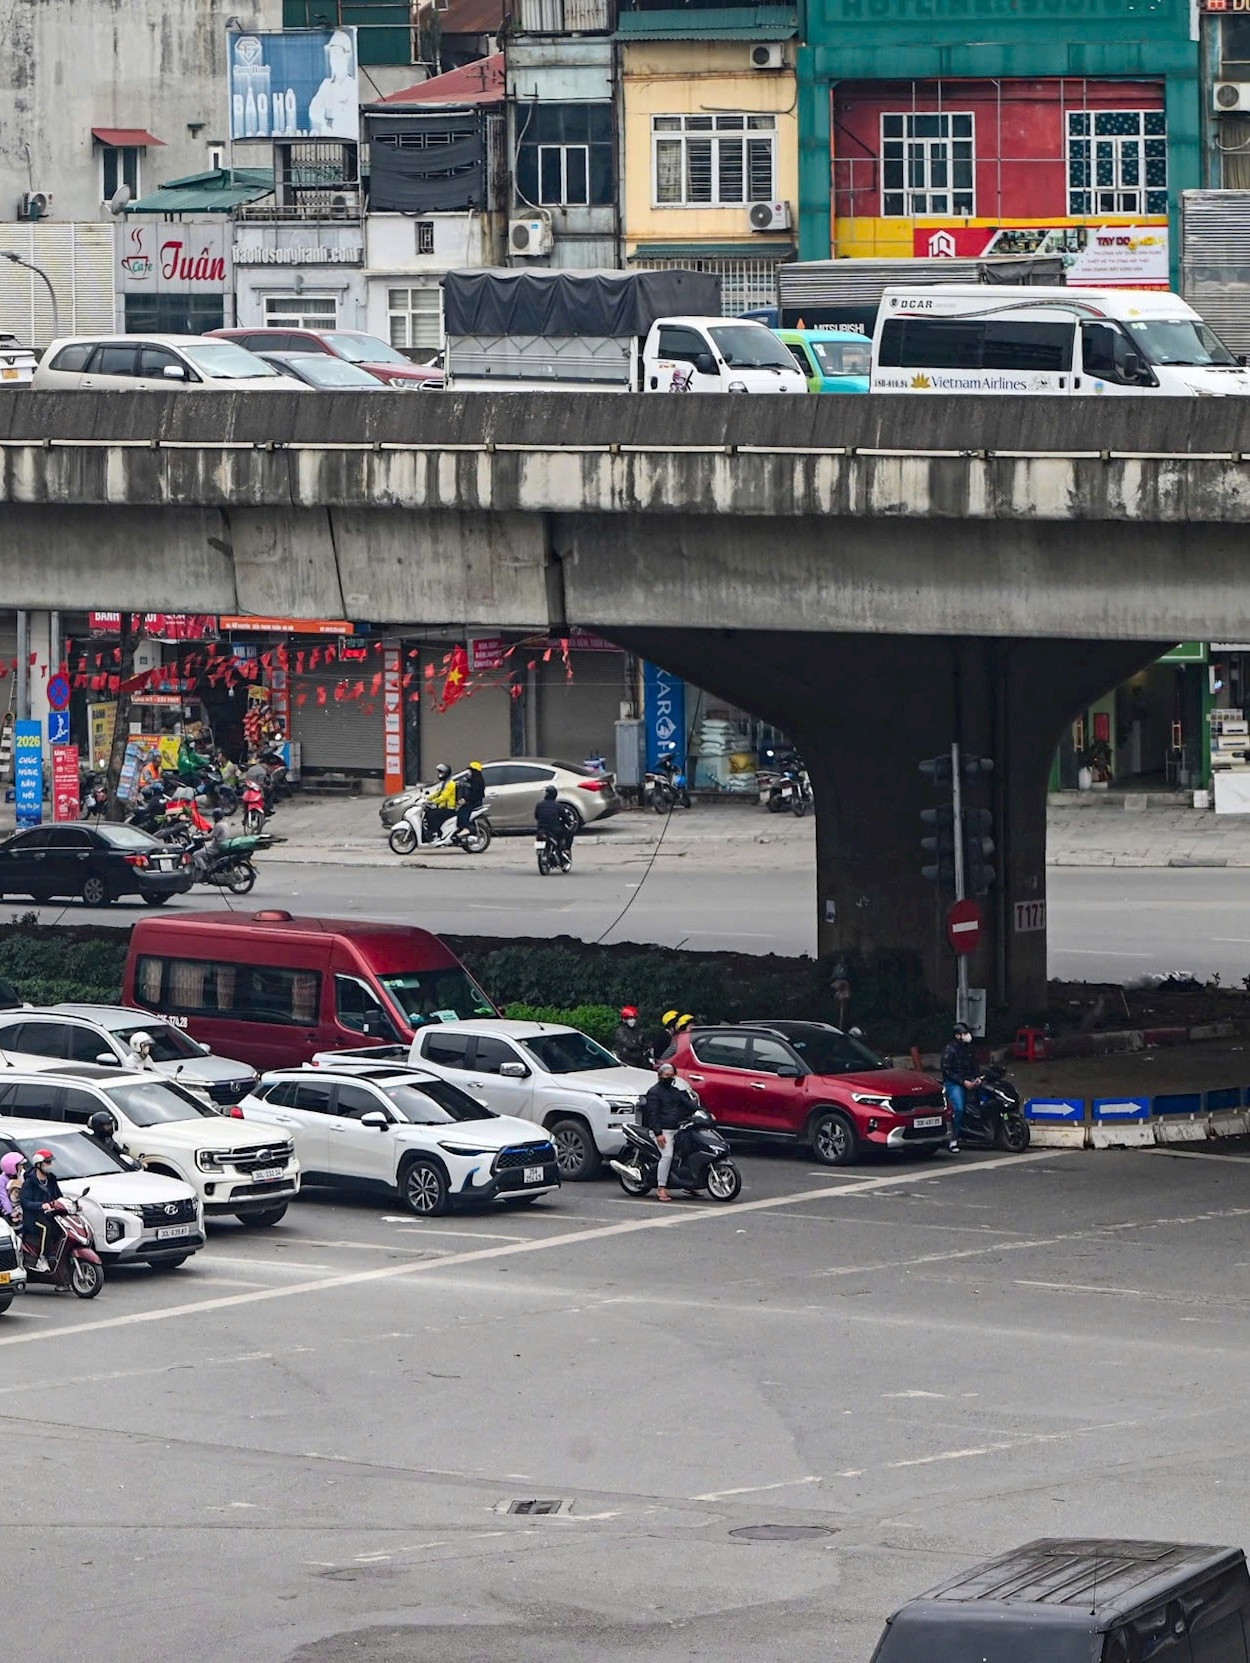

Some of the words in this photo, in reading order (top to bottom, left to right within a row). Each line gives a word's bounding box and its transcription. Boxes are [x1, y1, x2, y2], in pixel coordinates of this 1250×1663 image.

[160, 240, 227, 281] Tuấn
[931, 375, 981, 389] Vietnam
[982, 376, 1028, 391] Airlines
[16, 735, 41, 748] 2026
[1016, 902, 1044, 929] T177
